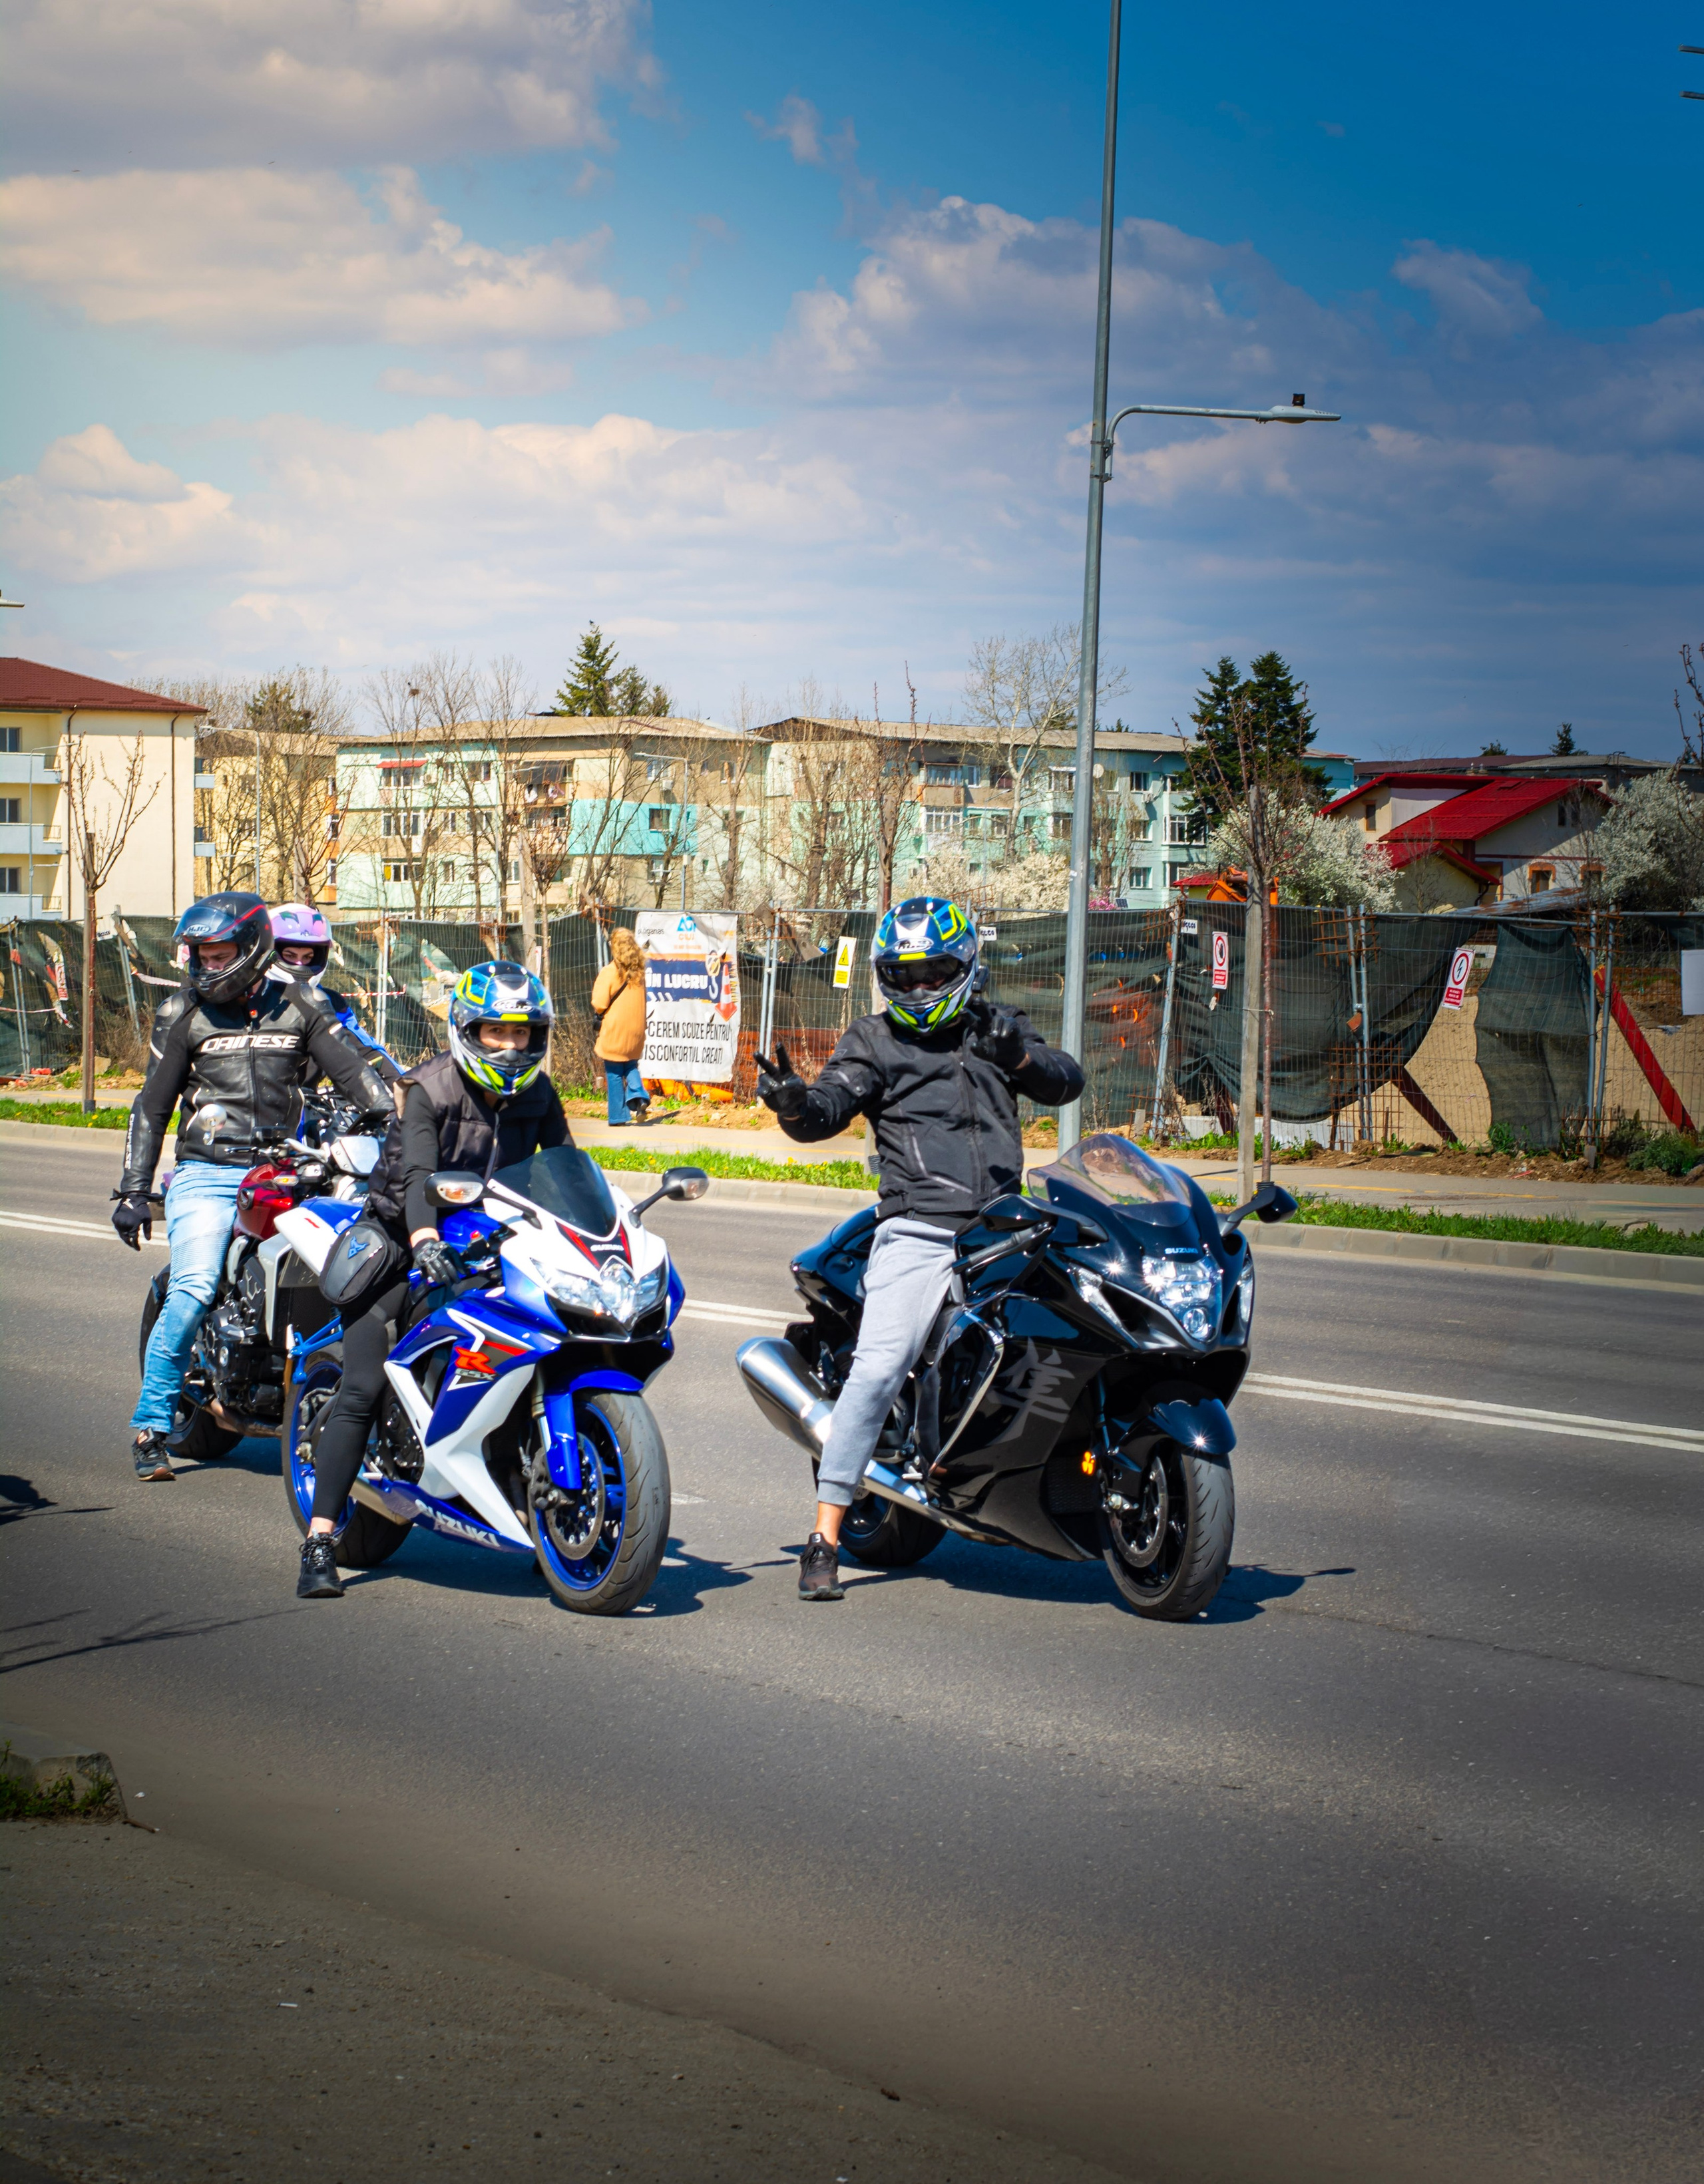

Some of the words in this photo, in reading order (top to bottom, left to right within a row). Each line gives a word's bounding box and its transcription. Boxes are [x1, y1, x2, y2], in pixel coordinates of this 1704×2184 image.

[664, 974, 708, 990] LUCRU
[648, 1021, 680, 1038] CEREM
[682, 1021, 705, 1039] SCUZE
[706, 1022, 730, 1041] PENTRU
[200, 1035, 300, 1053] DAINESE
[643, 1044, 700, 1063] ISCONFORTUL
[455, 1367, 497, 1381] GSX
[415, 1499, 501, 1548] SUZUKI
